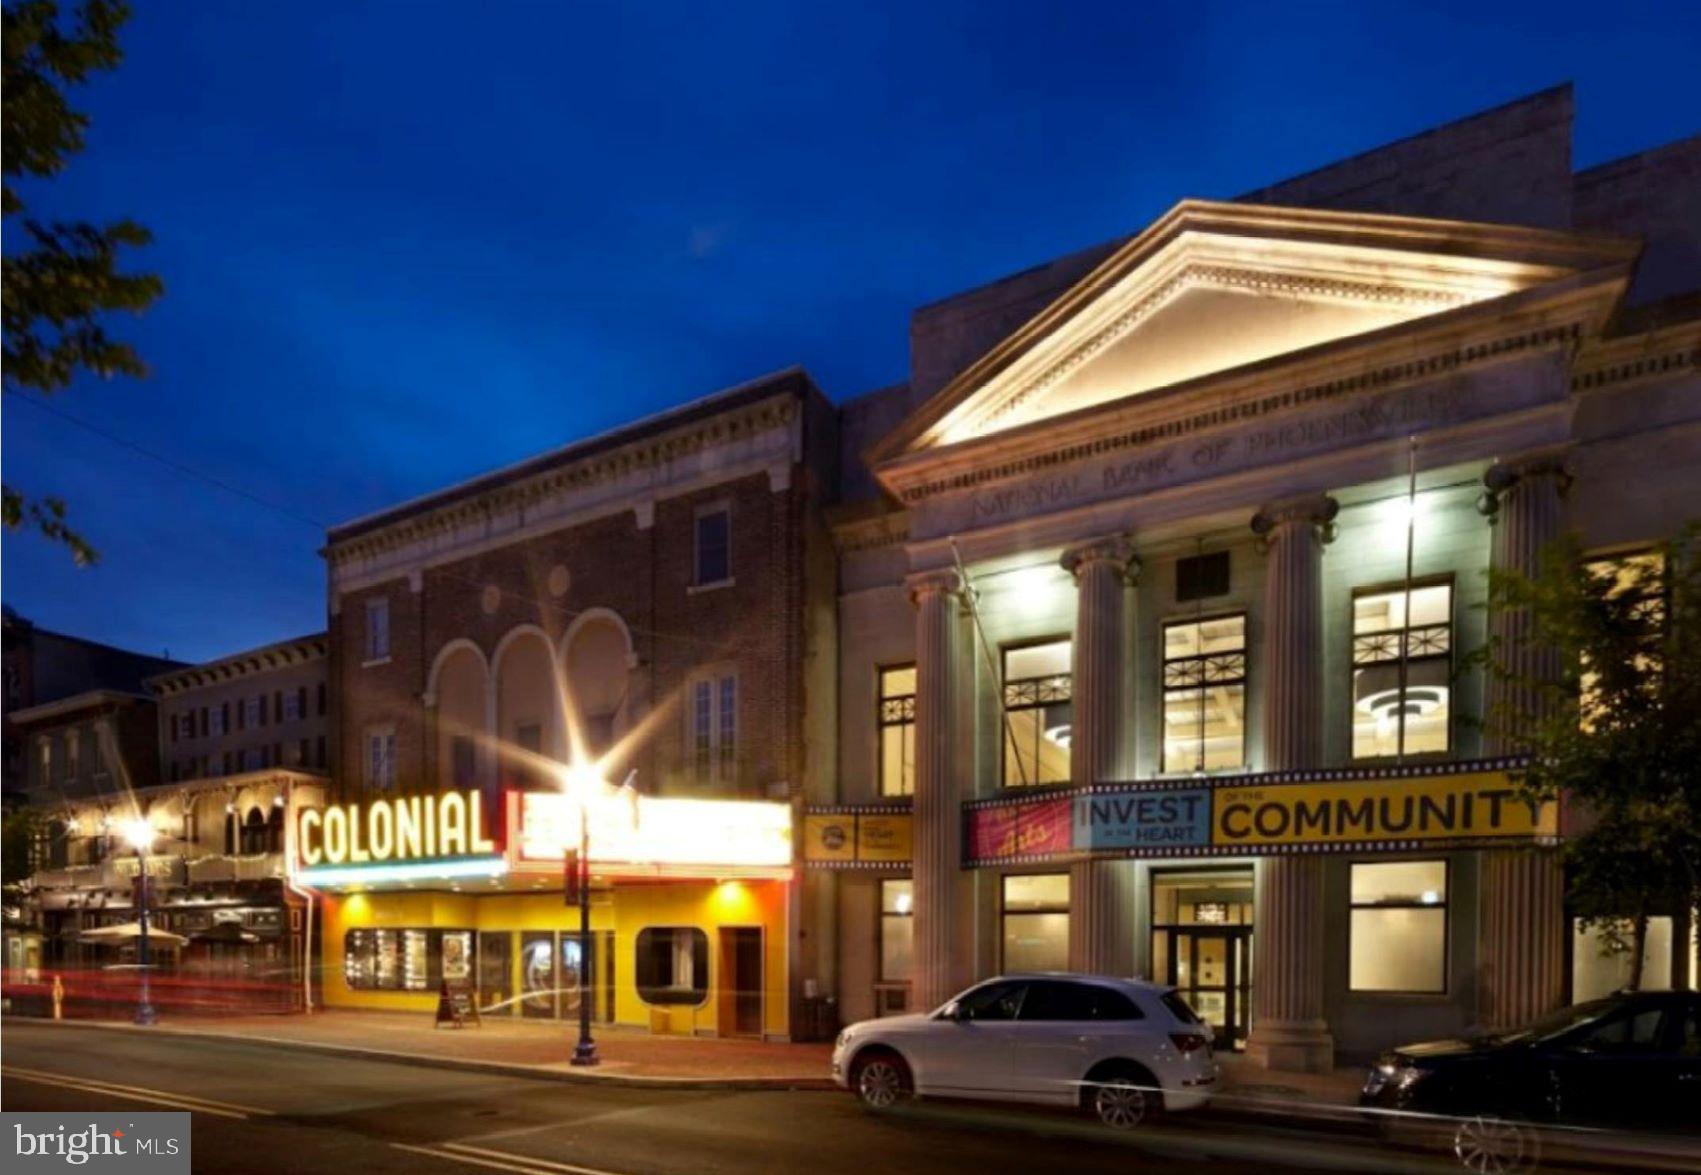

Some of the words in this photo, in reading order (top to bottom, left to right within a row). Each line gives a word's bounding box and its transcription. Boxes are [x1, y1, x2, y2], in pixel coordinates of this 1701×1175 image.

[973, 476, 1079, 515] NATIONAL
[1103, 452, 1175, 490] BANK
[1191, 437, 1233, 467] OF
[300, 791, 493, 864] COLONIAL
[1081, 795, 1203, 826] INVEST
[1136, 825, 1196, 841] HEART
[1220, 788, 1556, 839] COMMUNITY
